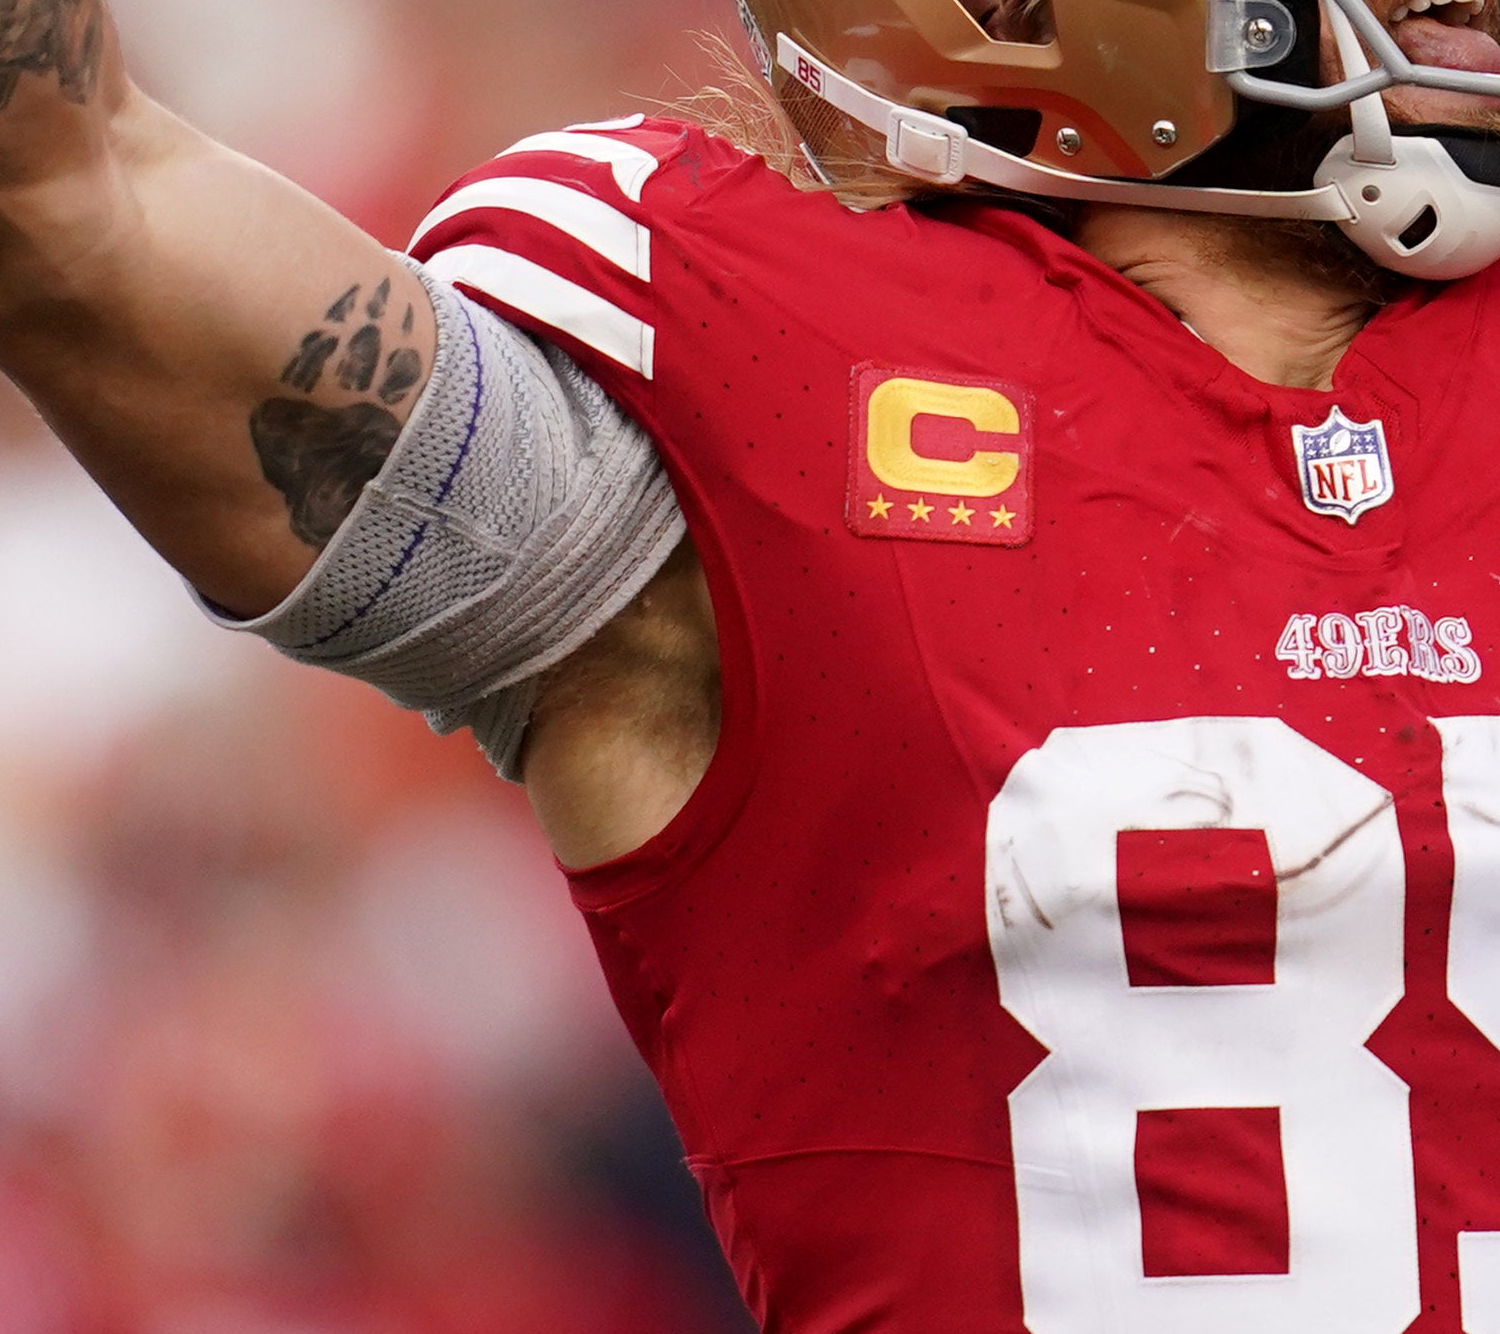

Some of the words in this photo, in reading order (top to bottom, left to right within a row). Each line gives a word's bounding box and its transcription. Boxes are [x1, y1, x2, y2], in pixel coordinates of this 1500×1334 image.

[798, 57, 821, 92] 85
[867, 378, 1020, 497] C
[1313, 459, 1378, 501] NFL
[1275, 605, 1483, 684] 49ERS
